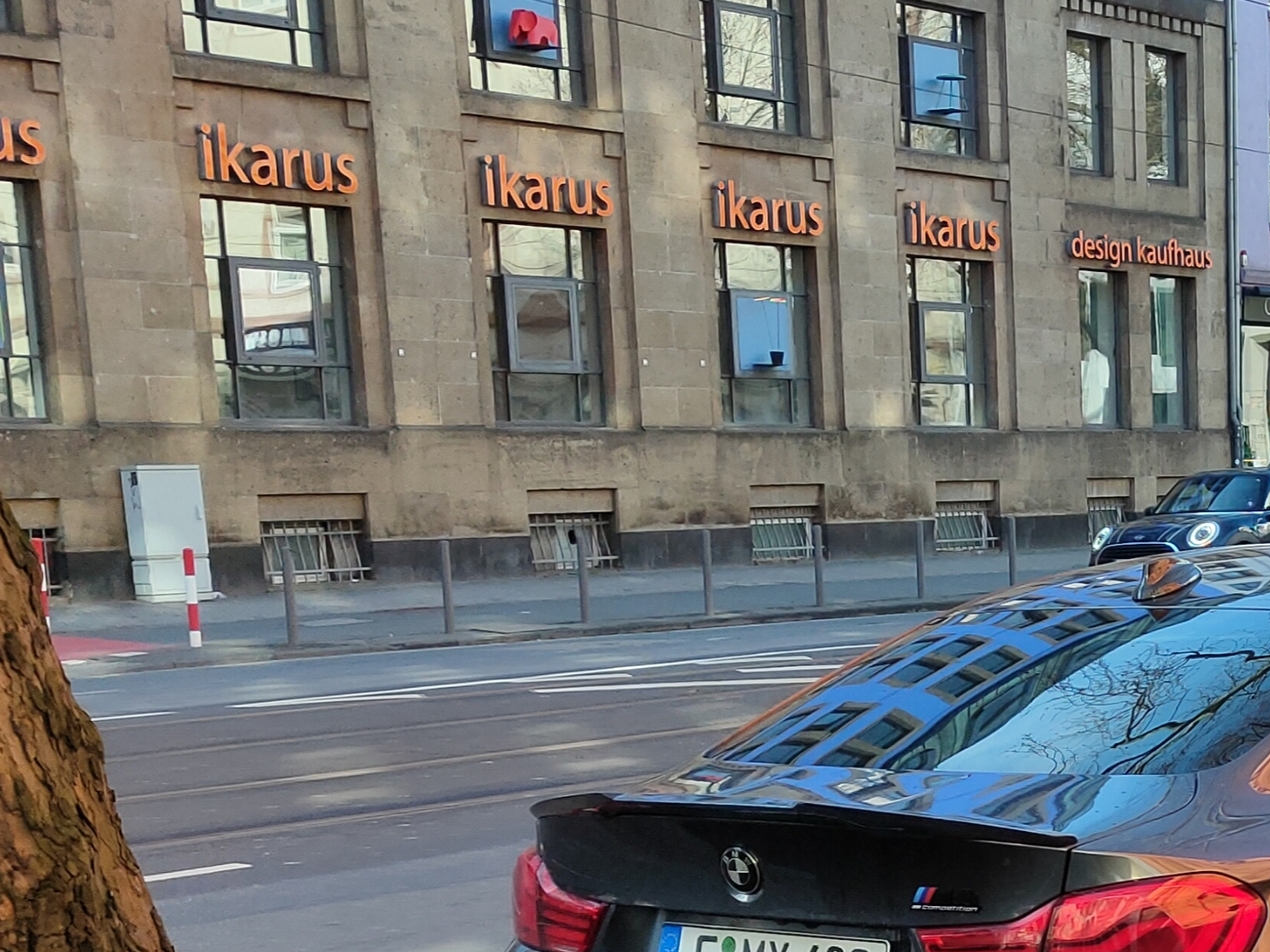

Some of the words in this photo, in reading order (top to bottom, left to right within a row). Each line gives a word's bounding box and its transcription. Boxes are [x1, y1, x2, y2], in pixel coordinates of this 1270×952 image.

[198, 122, 359, 194] ikarus
[482, 154, 614, 217] ikarus
[715, 179, 825, 236] ikarus
[907, 201, 1001, 252] ikarus
[1071, 230, 1132, 268] design
[1136, 235, 1213, 270] kaufhaus
